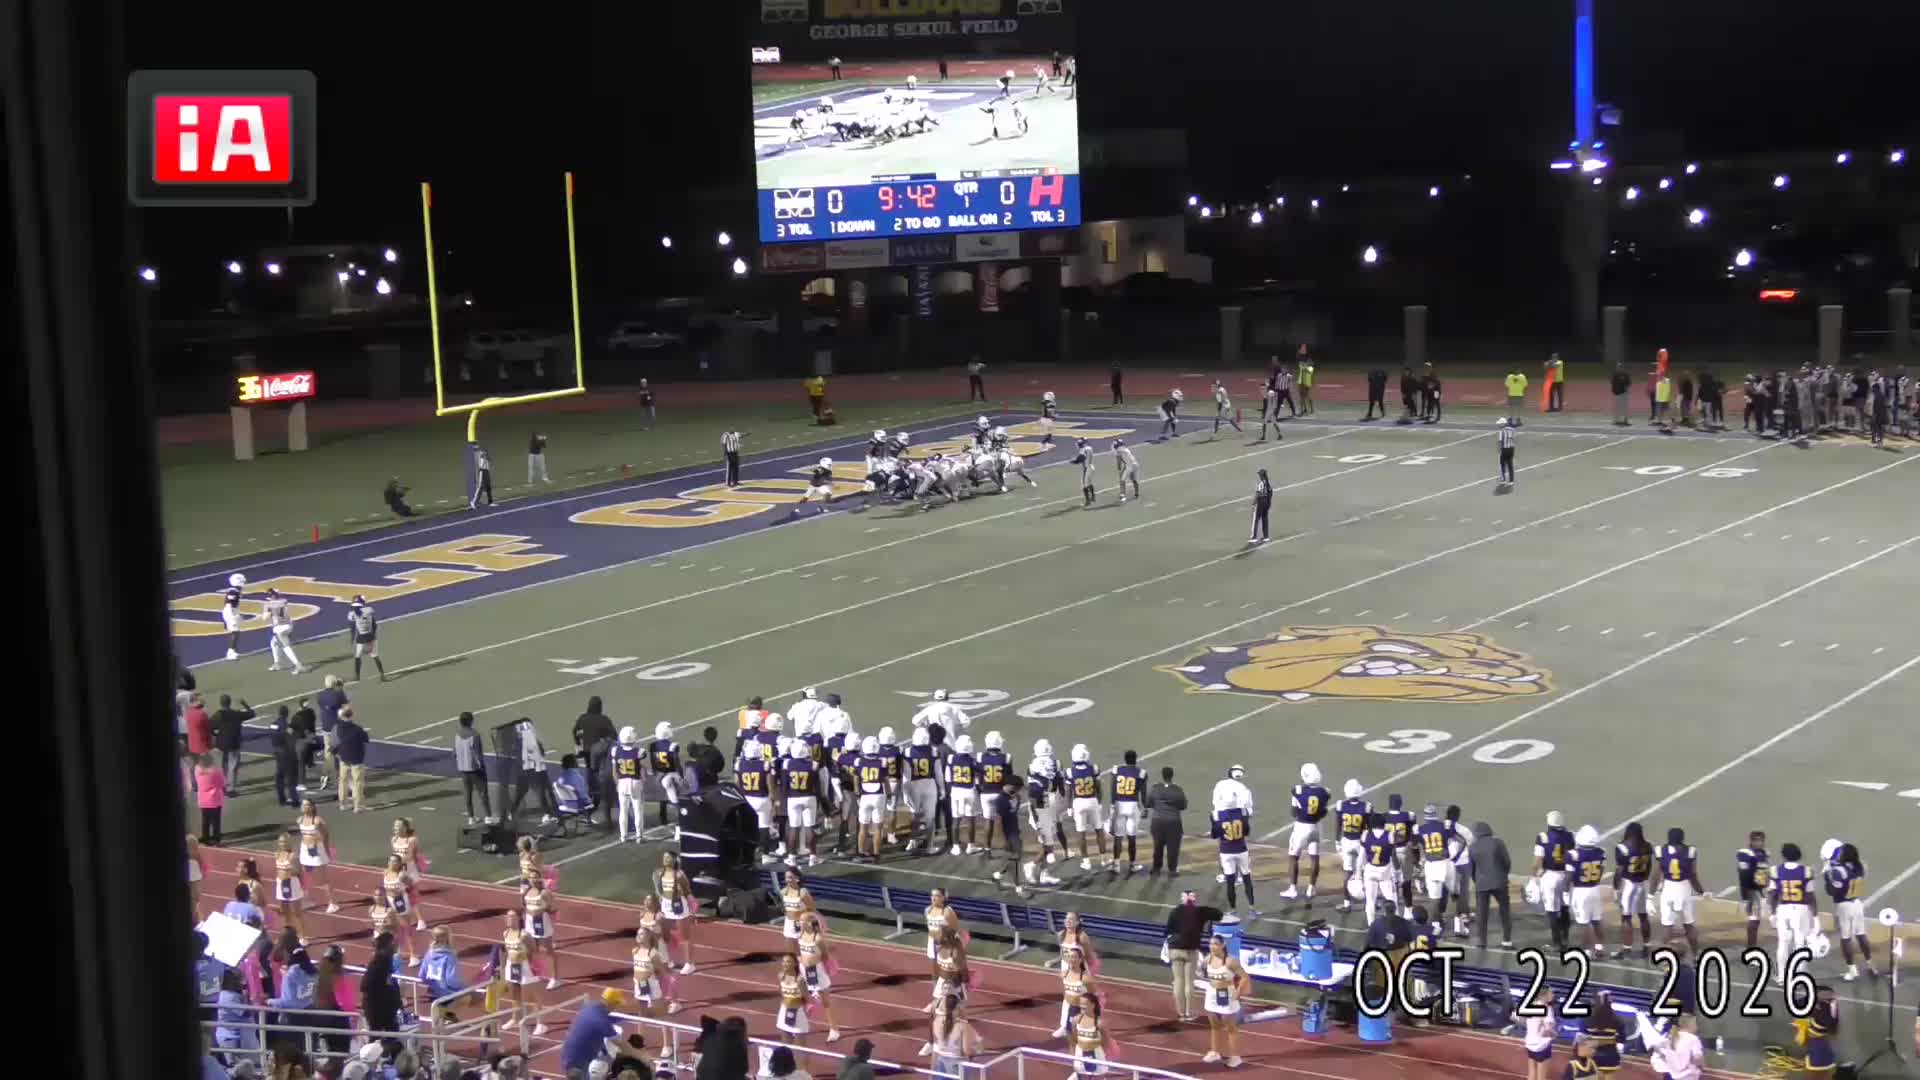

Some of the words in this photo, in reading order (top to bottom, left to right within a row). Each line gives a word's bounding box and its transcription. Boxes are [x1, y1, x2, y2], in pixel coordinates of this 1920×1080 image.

[809, 23, 889, 40] GEORGE
[960, 19, 1018, 34] FIELD
[953, 181, 979, 196] QTR
[1000, 180, 1016, 205] 0
[827, 189, 844, 214] 0
[878, 183, 937, 212] 9:42
[893, 217, 903, 231] 2
[904, 217, 922, 230] TO
[922, 215, 942, 229] GO
[948, 213, 978, 228] BALL
[978, 212, 998, 226] ON
[1003, 211, 1013, 225] 2
[1030, 210, 1055, 224] TOL
[1057, 208, 1066, 223] 3
[788, 222, 813, 236] TOL
[836, 219, 876, 234] DOWN
[912, 758, 930, 776] 19
[953, 765, 971, 783] 23
[983, 764, 1003, 783] 36
[741, 771, 760, 791] 97
[789, 771, 809, 790] 37
[1074, 776, 1095, 796] 22
[1116, 775, 1137, 796] 20
[1221, 821, 1244, 842] 30
[1781, 879, 1803, 902] 15
